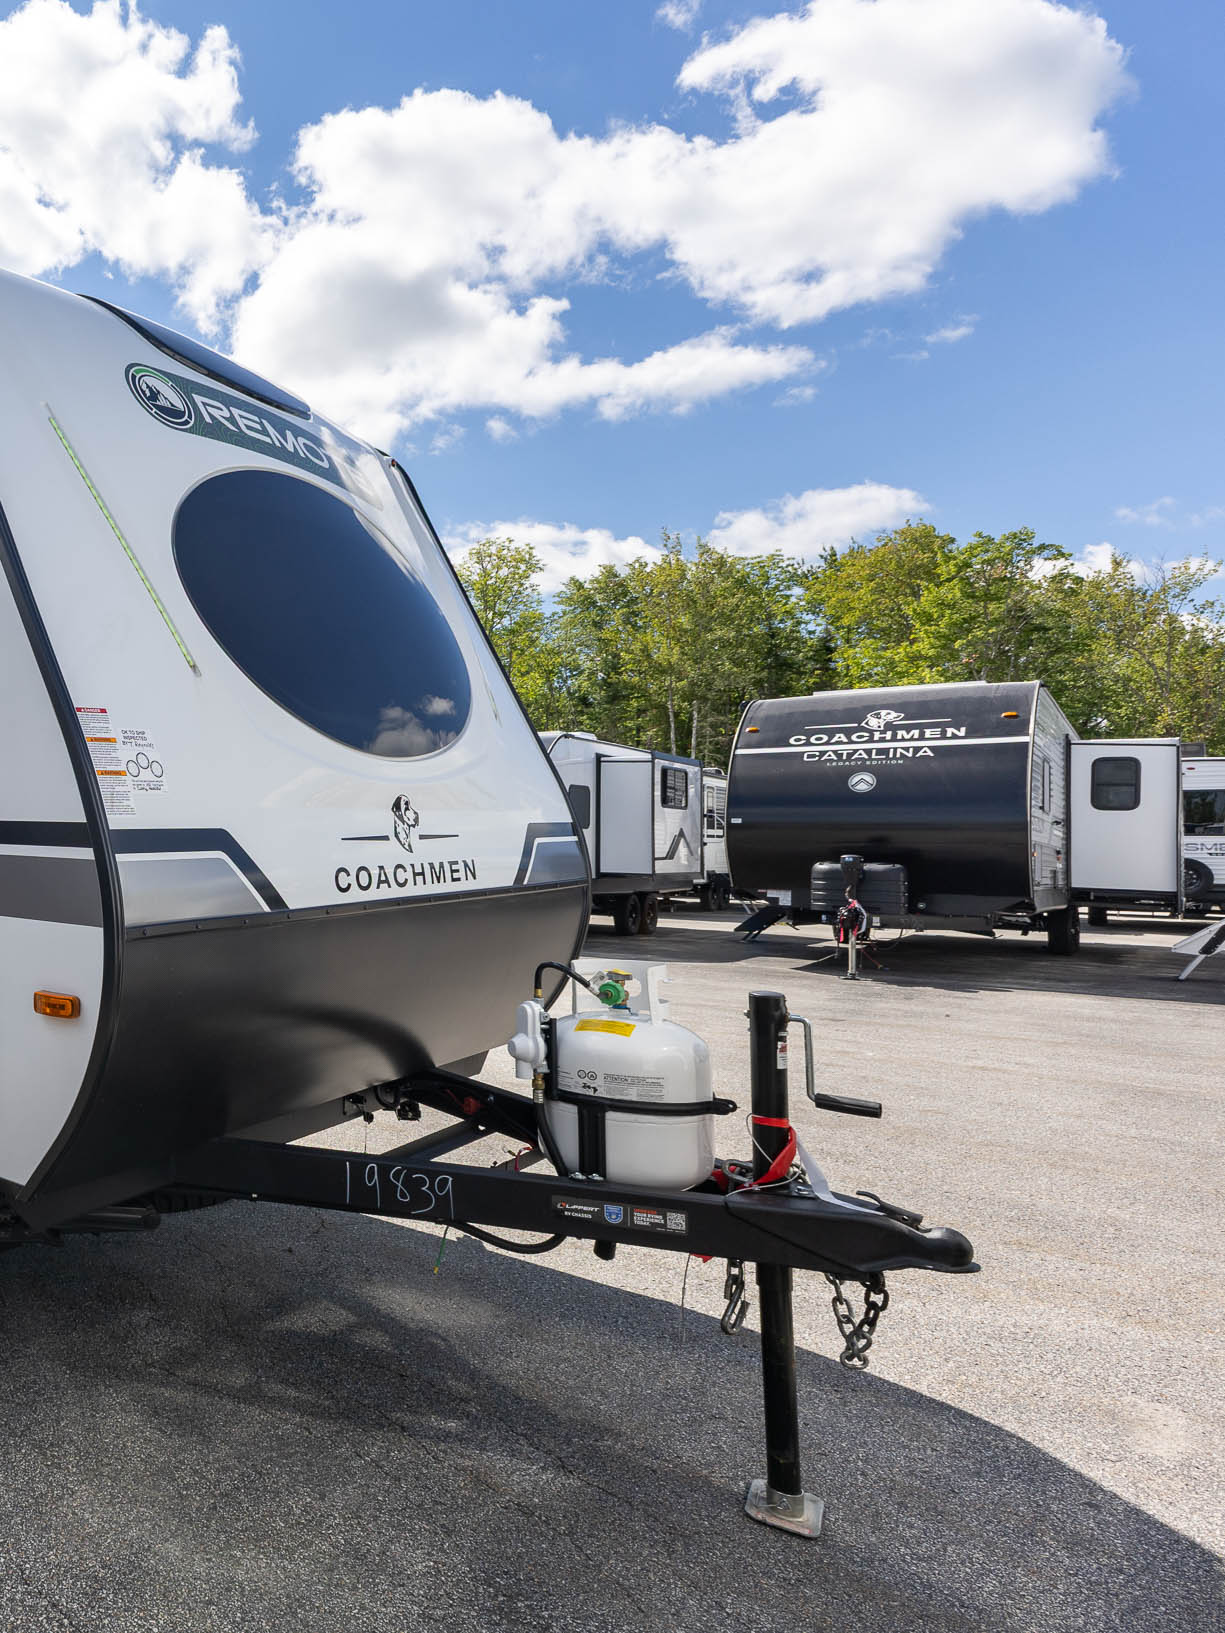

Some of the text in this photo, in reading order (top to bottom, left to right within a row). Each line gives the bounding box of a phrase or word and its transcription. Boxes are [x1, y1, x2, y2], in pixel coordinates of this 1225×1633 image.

[191, 393, 344, 478] REMO
[788, 727, 966, 745] COACHMEN
[803, 747, 935, 762] CATALINA
[334, 859, 477, 894] COACHMEN
[345, 1161, 455, 1221] 19839
